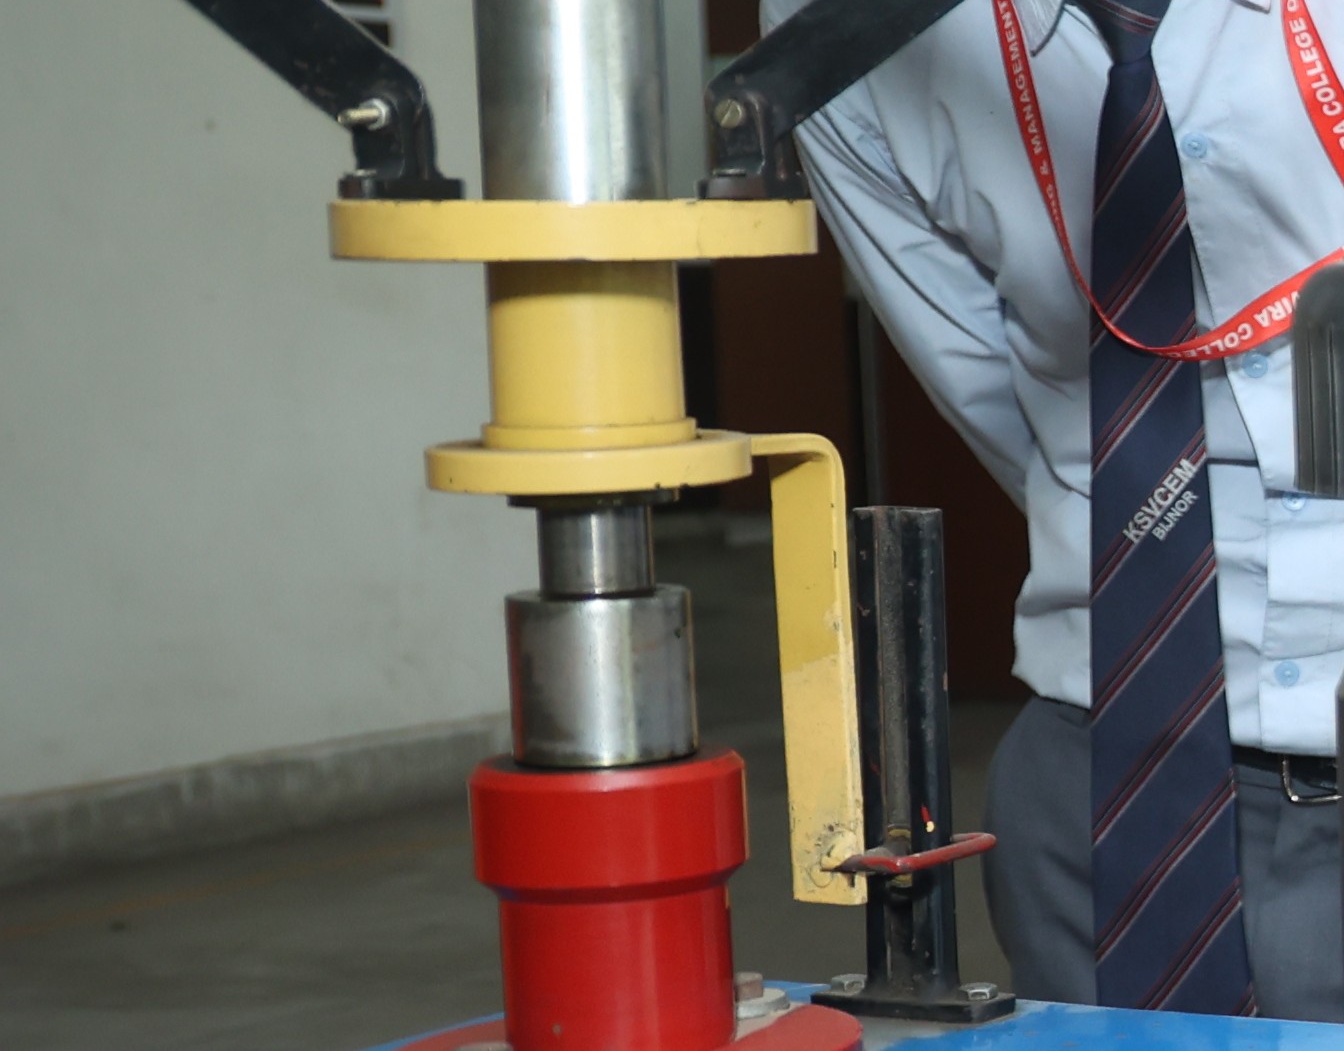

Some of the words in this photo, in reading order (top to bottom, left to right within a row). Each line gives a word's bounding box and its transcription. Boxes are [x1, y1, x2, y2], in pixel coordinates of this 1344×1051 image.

[1288, 17, 1343, 116] COLLEGE
[1122, 458, 1198, 545] KSVCEM
[1152, 490, 1198, 541] BIJNOR
